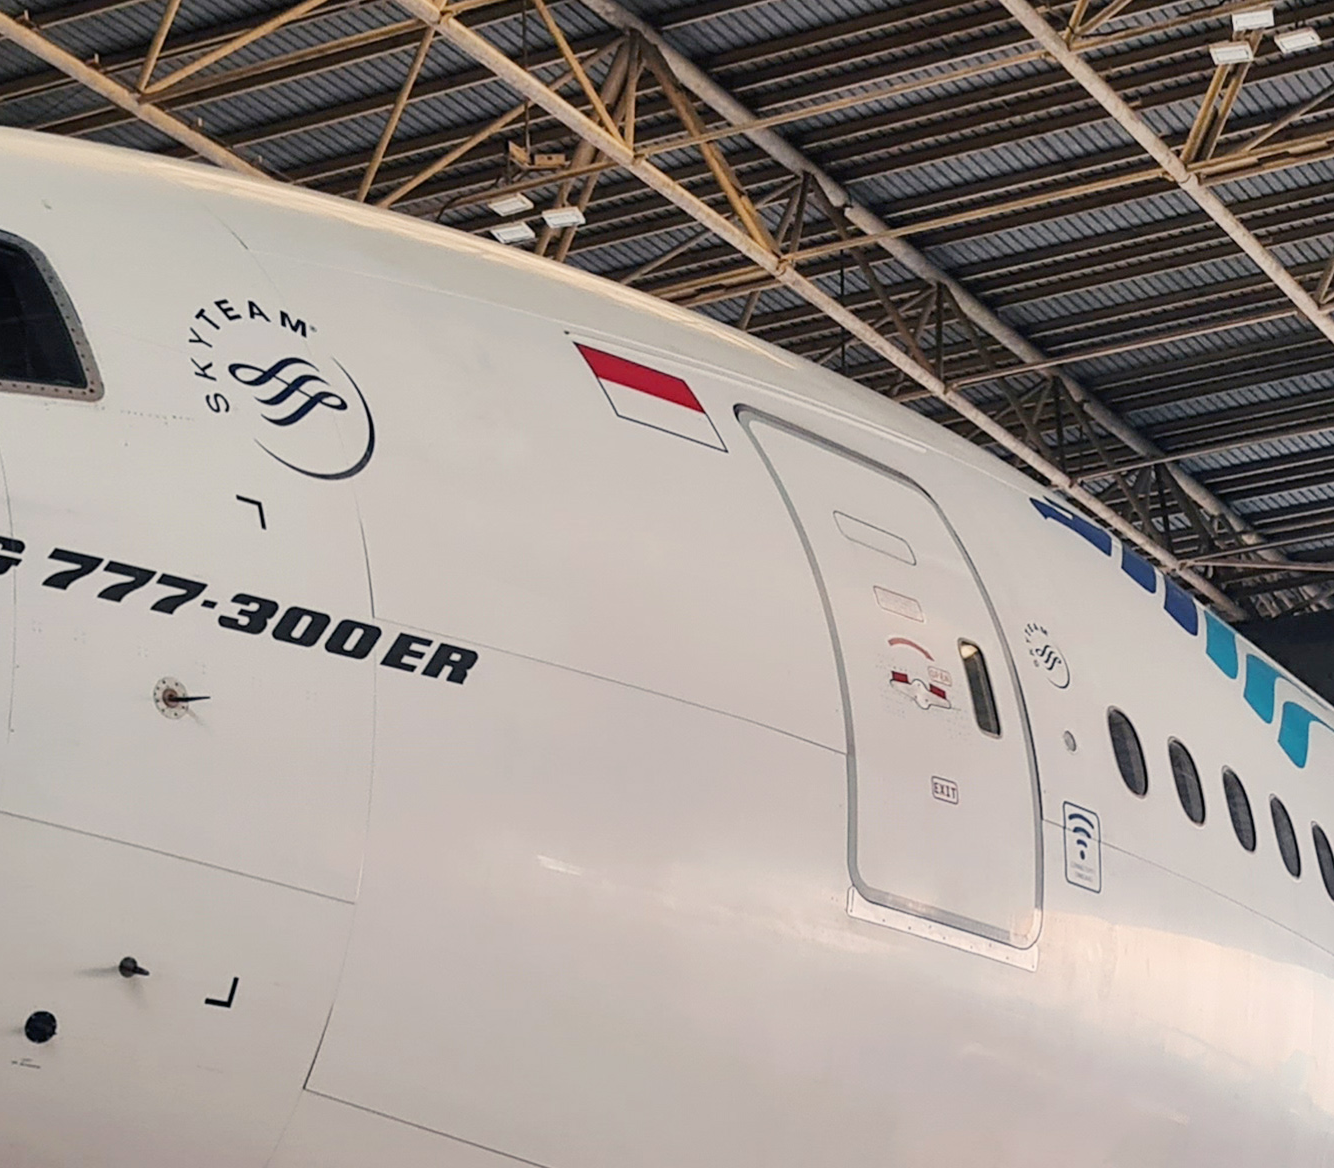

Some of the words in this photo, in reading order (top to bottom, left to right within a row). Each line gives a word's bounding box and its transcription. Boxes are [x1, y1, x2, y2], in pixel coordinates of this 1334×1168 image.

[188, 299, 307, 413] SKYTEAM
[42, 547, 478, 684] 777-300ER
[934, 782, 956, 799] EXIT
